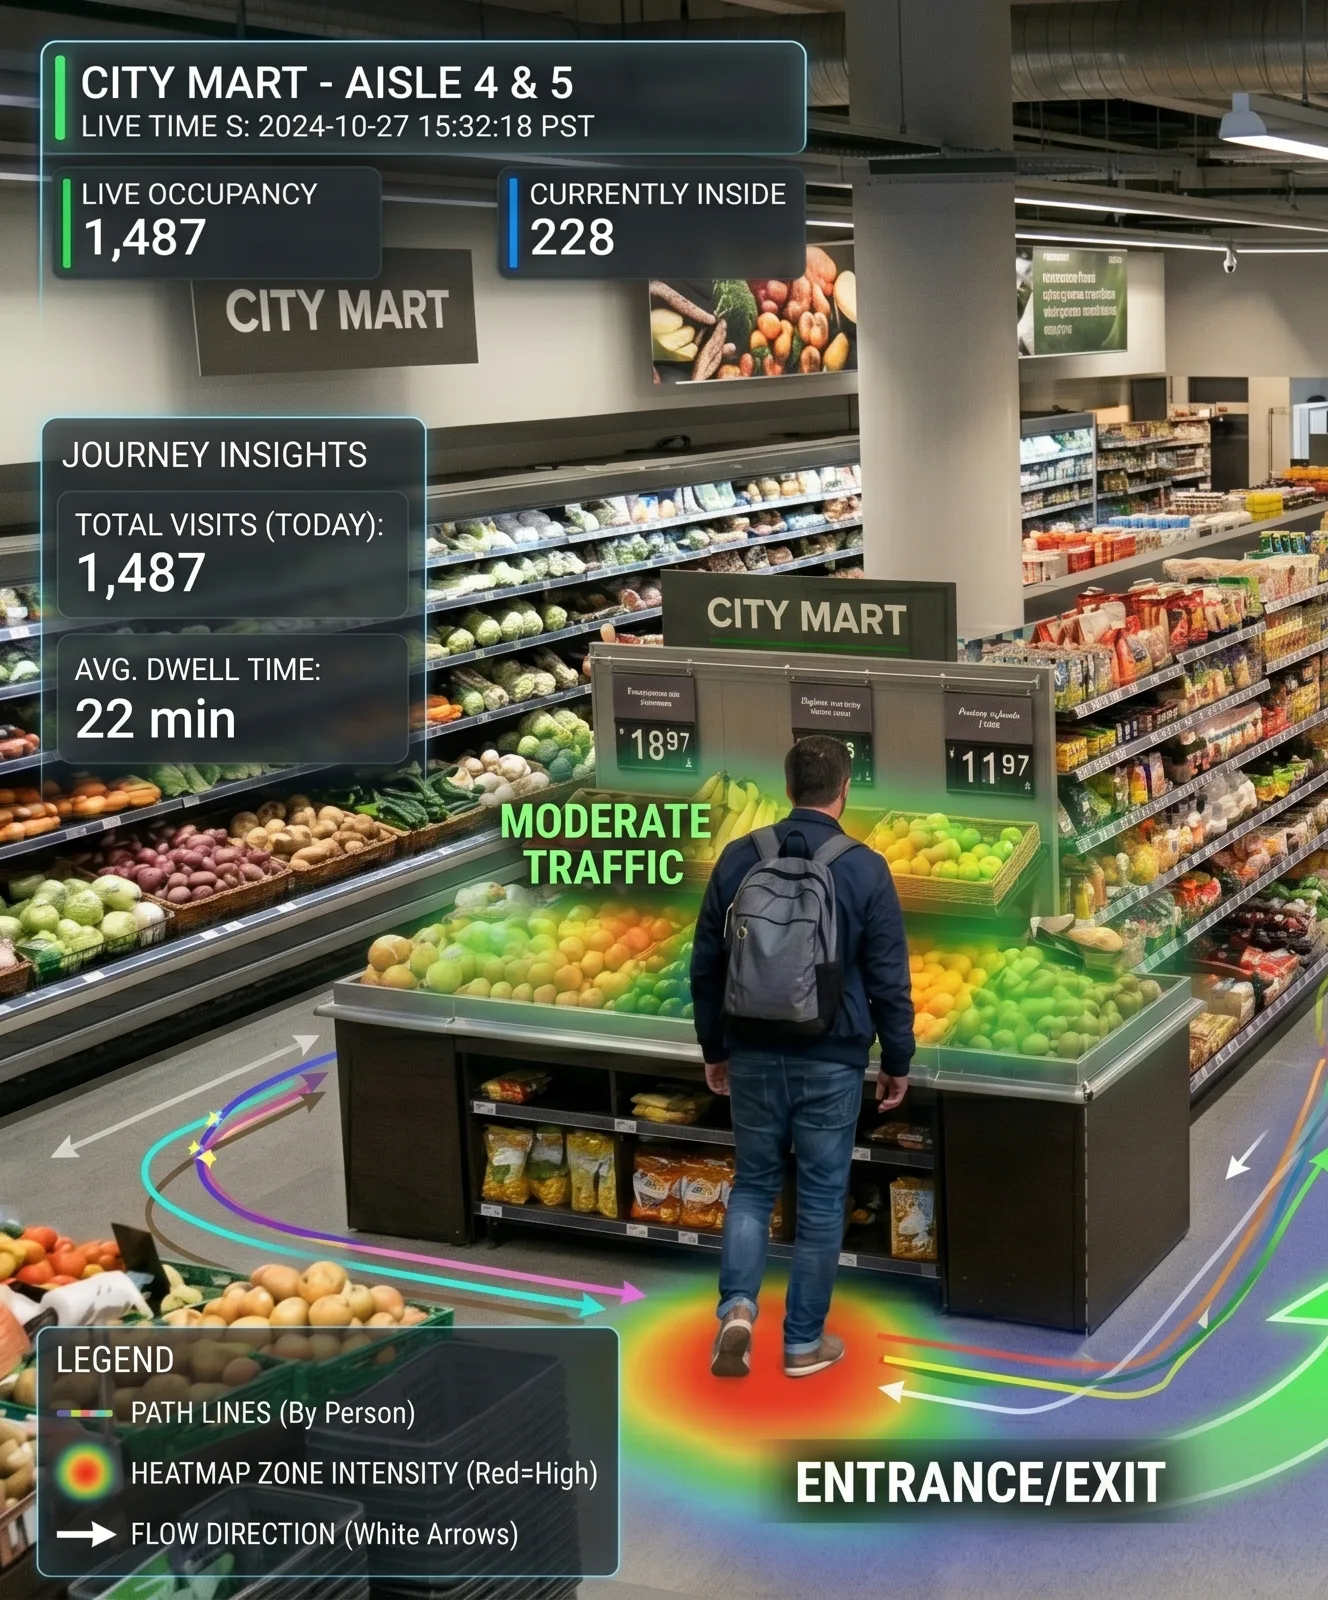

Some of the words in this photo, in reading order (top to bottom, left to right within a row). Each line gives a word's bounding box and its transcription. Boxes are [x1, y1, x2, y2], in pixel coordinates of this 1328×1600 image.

[226, 289, 325, 333] CITY
[338, 289, 450, 330] MART
[707, 597, 790, 630] CITY
[801, 600, 907, 635] MART
